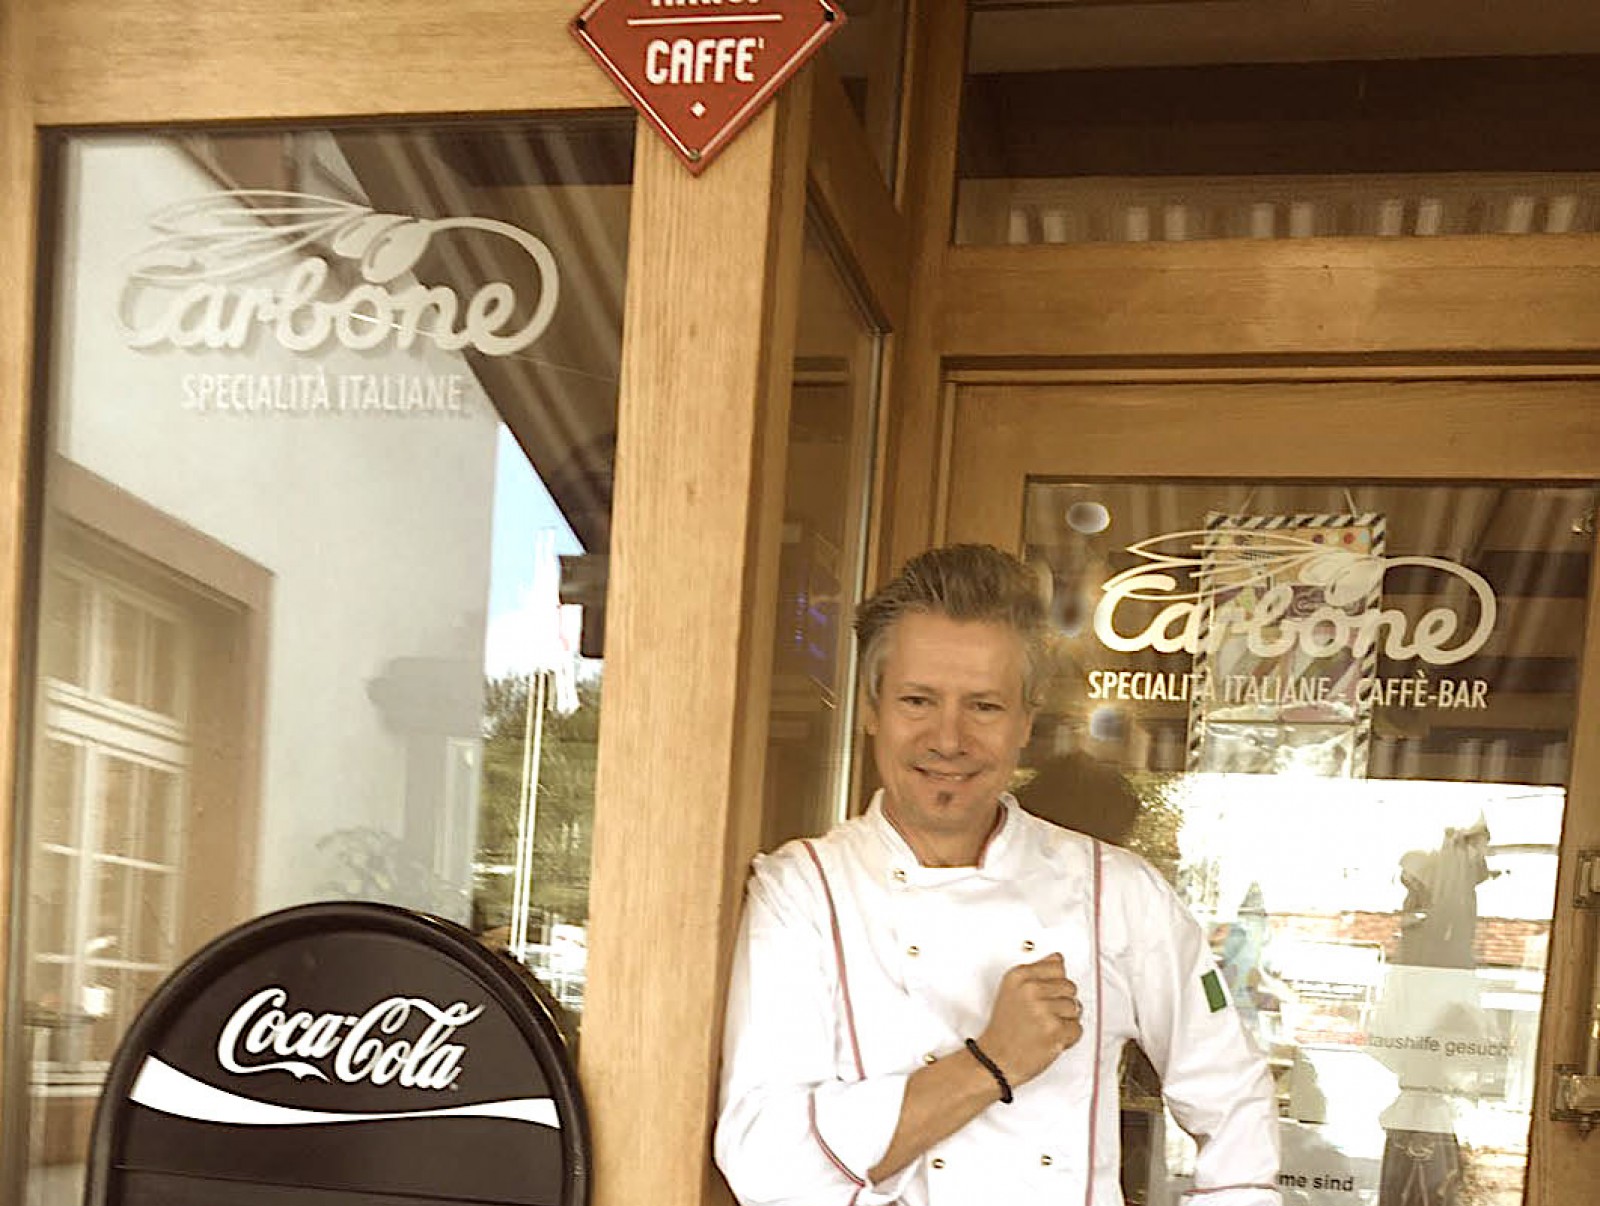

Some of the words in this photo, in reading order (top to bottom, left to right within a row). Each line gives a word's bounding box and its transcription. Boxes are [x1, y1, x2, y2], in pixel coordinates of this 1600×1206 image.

[117, 217, 558, 356] Carbone
[181, 365, 330, 411] SPECIALITÀ
[337, 373, 463, 411] ITALIANE
[1094, 556, 1497, 665] Carbone
[1087, 667, 1216, 702] SPECIALITÀ
[1224, 674, 1331, 704] ITALIANE
[1355, 669, 1489, 709] CAFFÈ-BAR
[217, 987, 486, 1090] Coca-Cola
[1445, 1039, 1513, 1057] gesuch
[1276, 1174, 1307, 1188] me
[1313, 1174, 1354, 1191] sind
